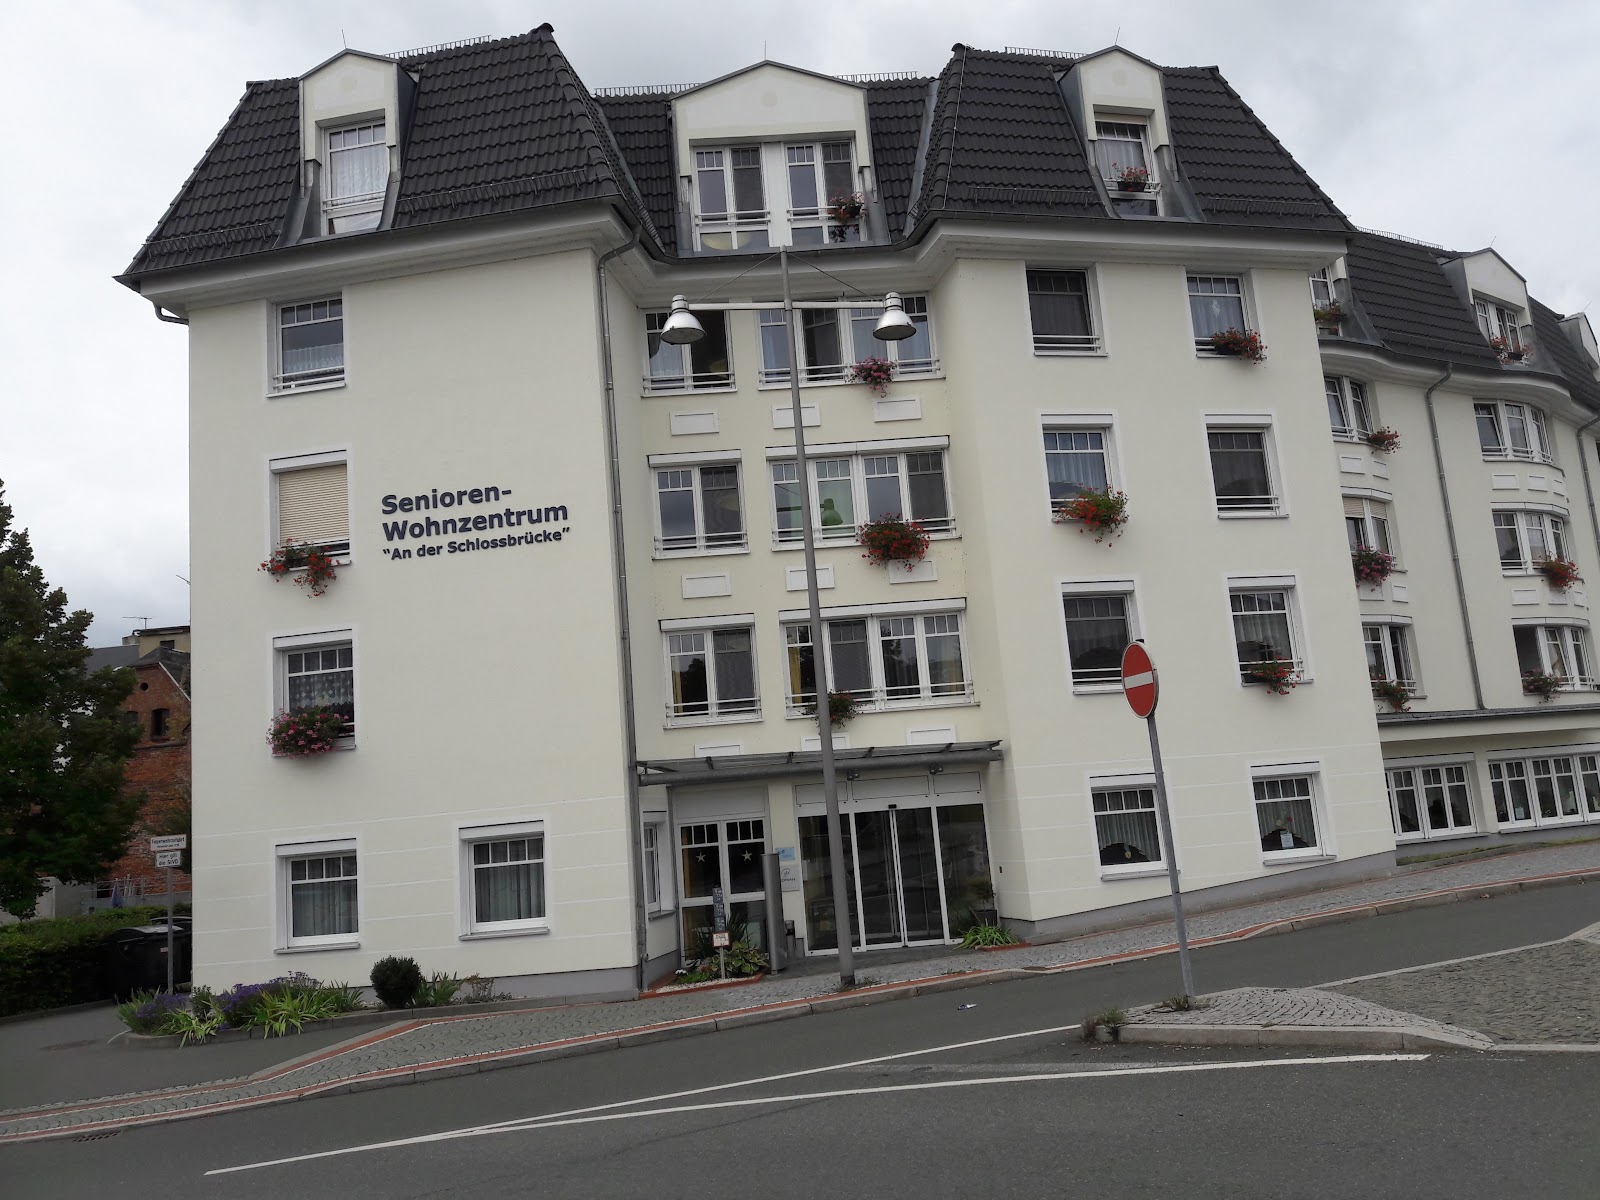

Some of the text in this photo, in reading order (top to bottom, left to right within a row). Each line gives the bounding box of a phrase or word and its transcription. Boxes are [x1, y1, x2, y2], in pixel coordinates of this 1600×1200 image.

[381, 486, 512, 514] Senioren-
[381, 504, 568, 541] Wohnzentrum
[416, 544, 443, 557] der
